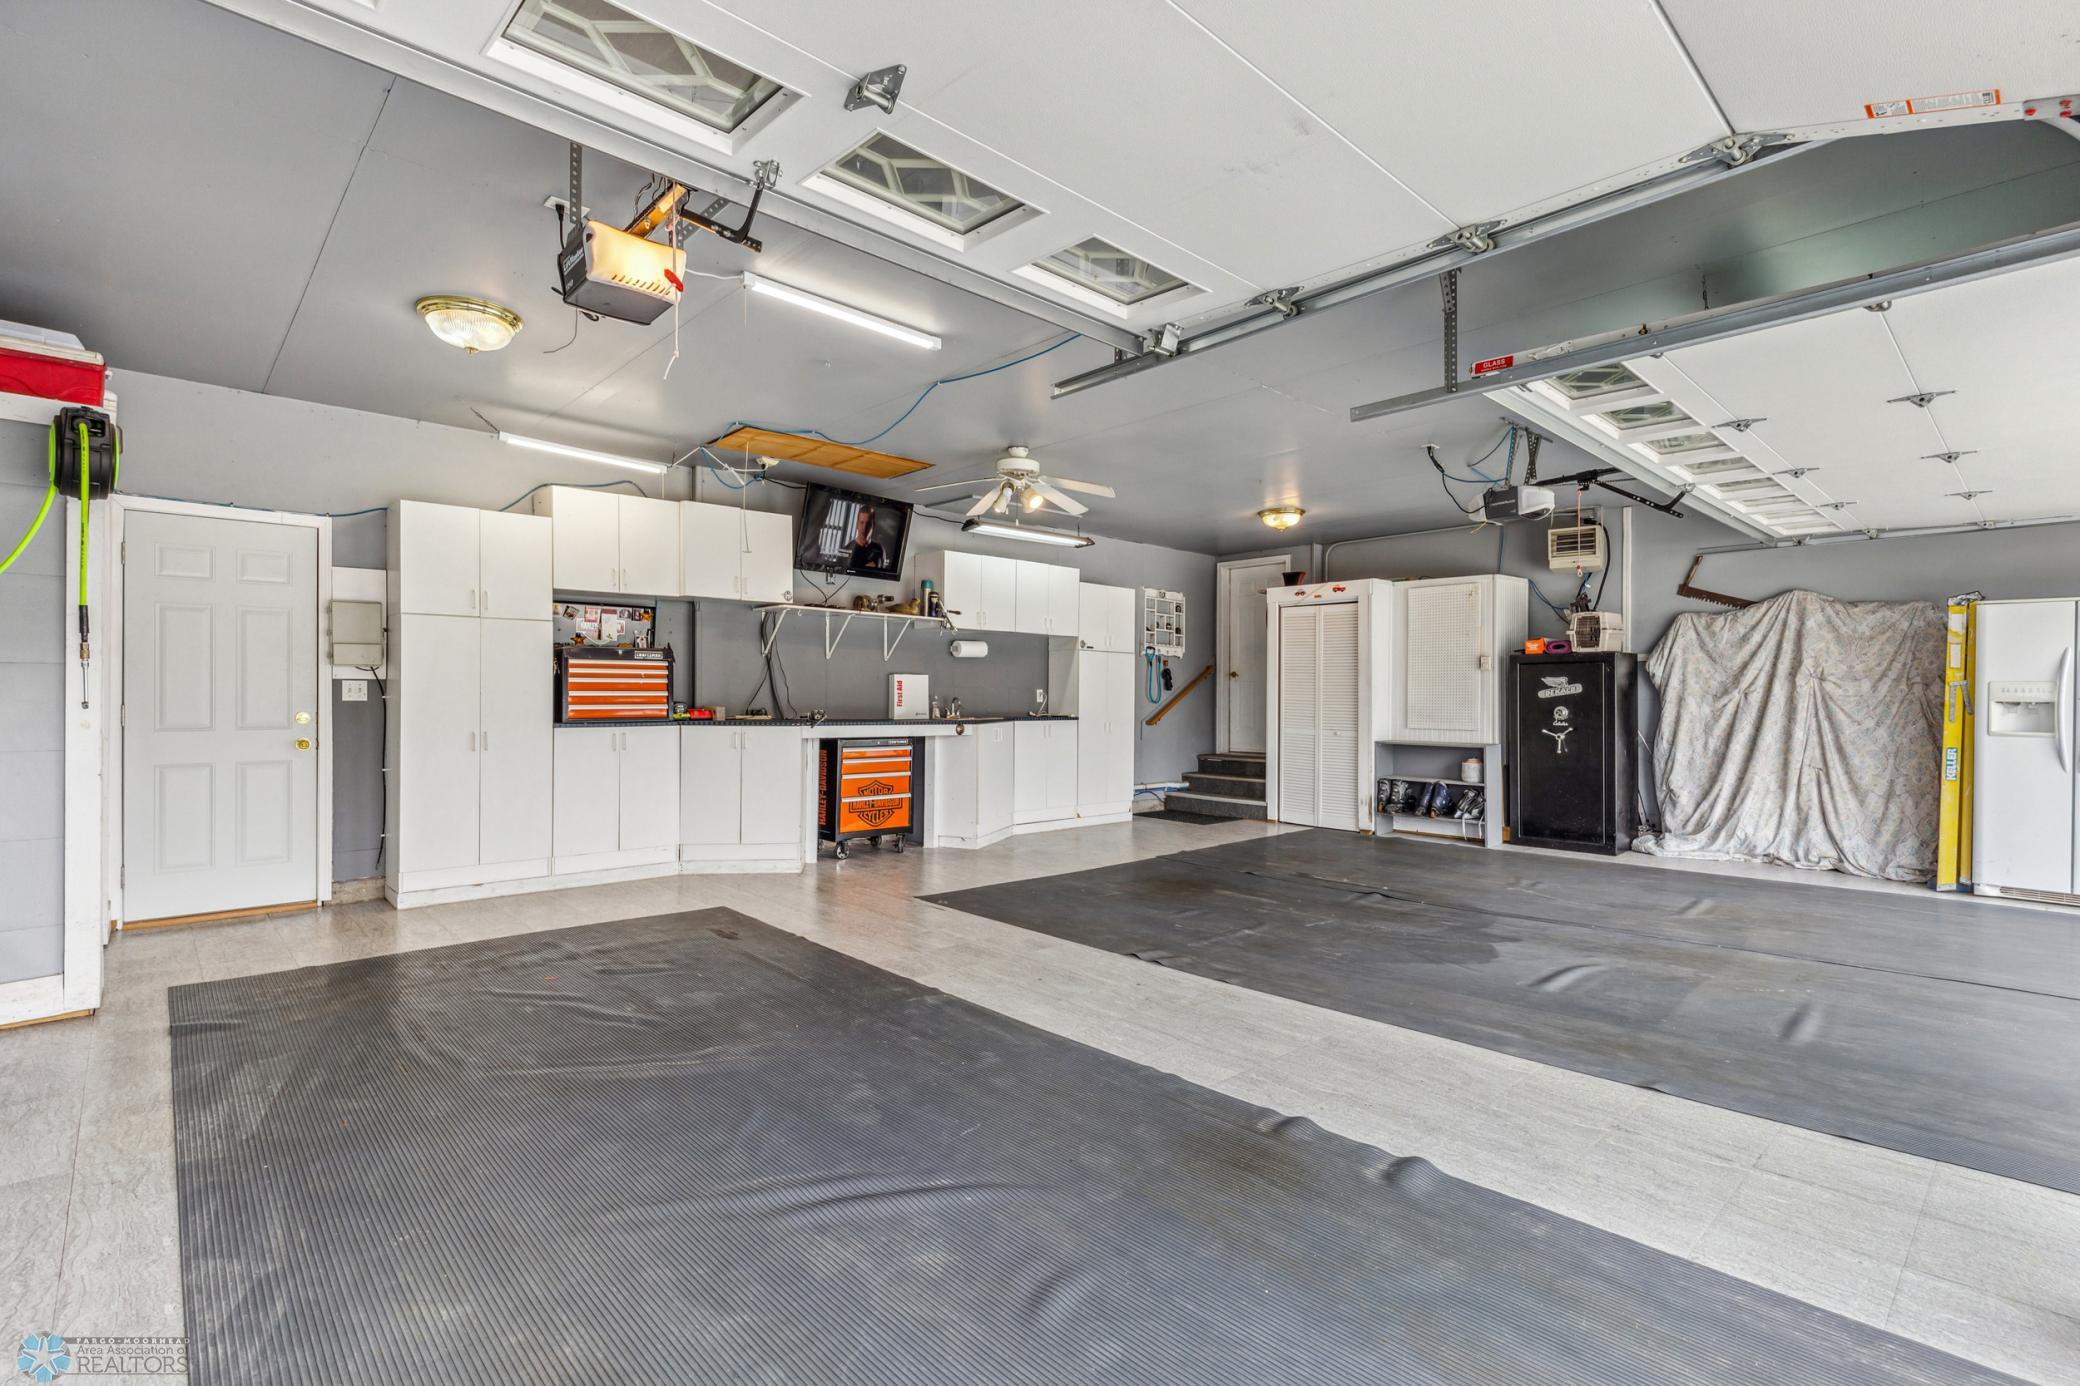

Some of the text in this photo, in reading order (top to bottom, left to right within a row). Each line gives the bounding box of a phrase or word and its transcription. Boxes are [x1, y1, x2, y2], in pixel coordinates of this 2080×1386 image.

[1483, 358, 1506, 369] GLASS
[1946, 748, 1957, 780] KELLER
[818, 749, 827, 826] HARLEY-DAVIDSON
